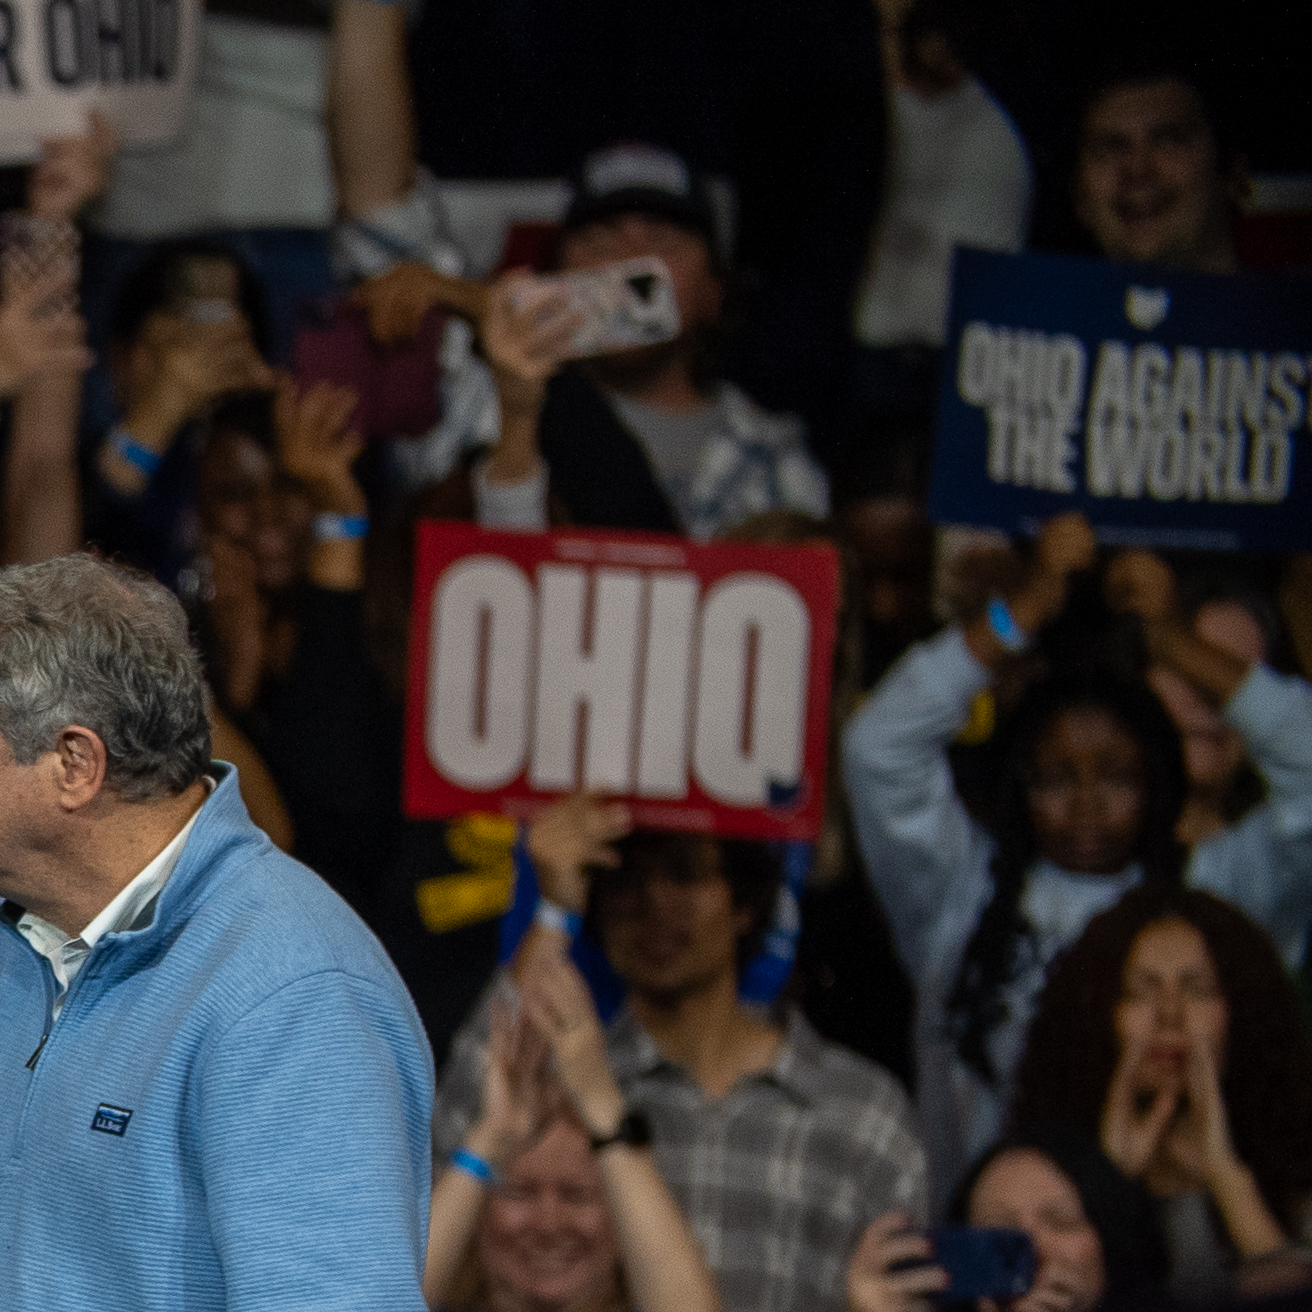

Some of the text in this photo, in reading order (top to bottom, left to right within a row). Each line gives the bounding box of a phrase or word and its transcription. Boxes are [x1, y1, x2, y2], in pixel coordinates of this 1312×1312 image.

[957, 320, 1312, 434] OHIO AGAINS
[987, 398, 1294, 504] THE WORLD
[423, 552, 813, 809] OHIO
